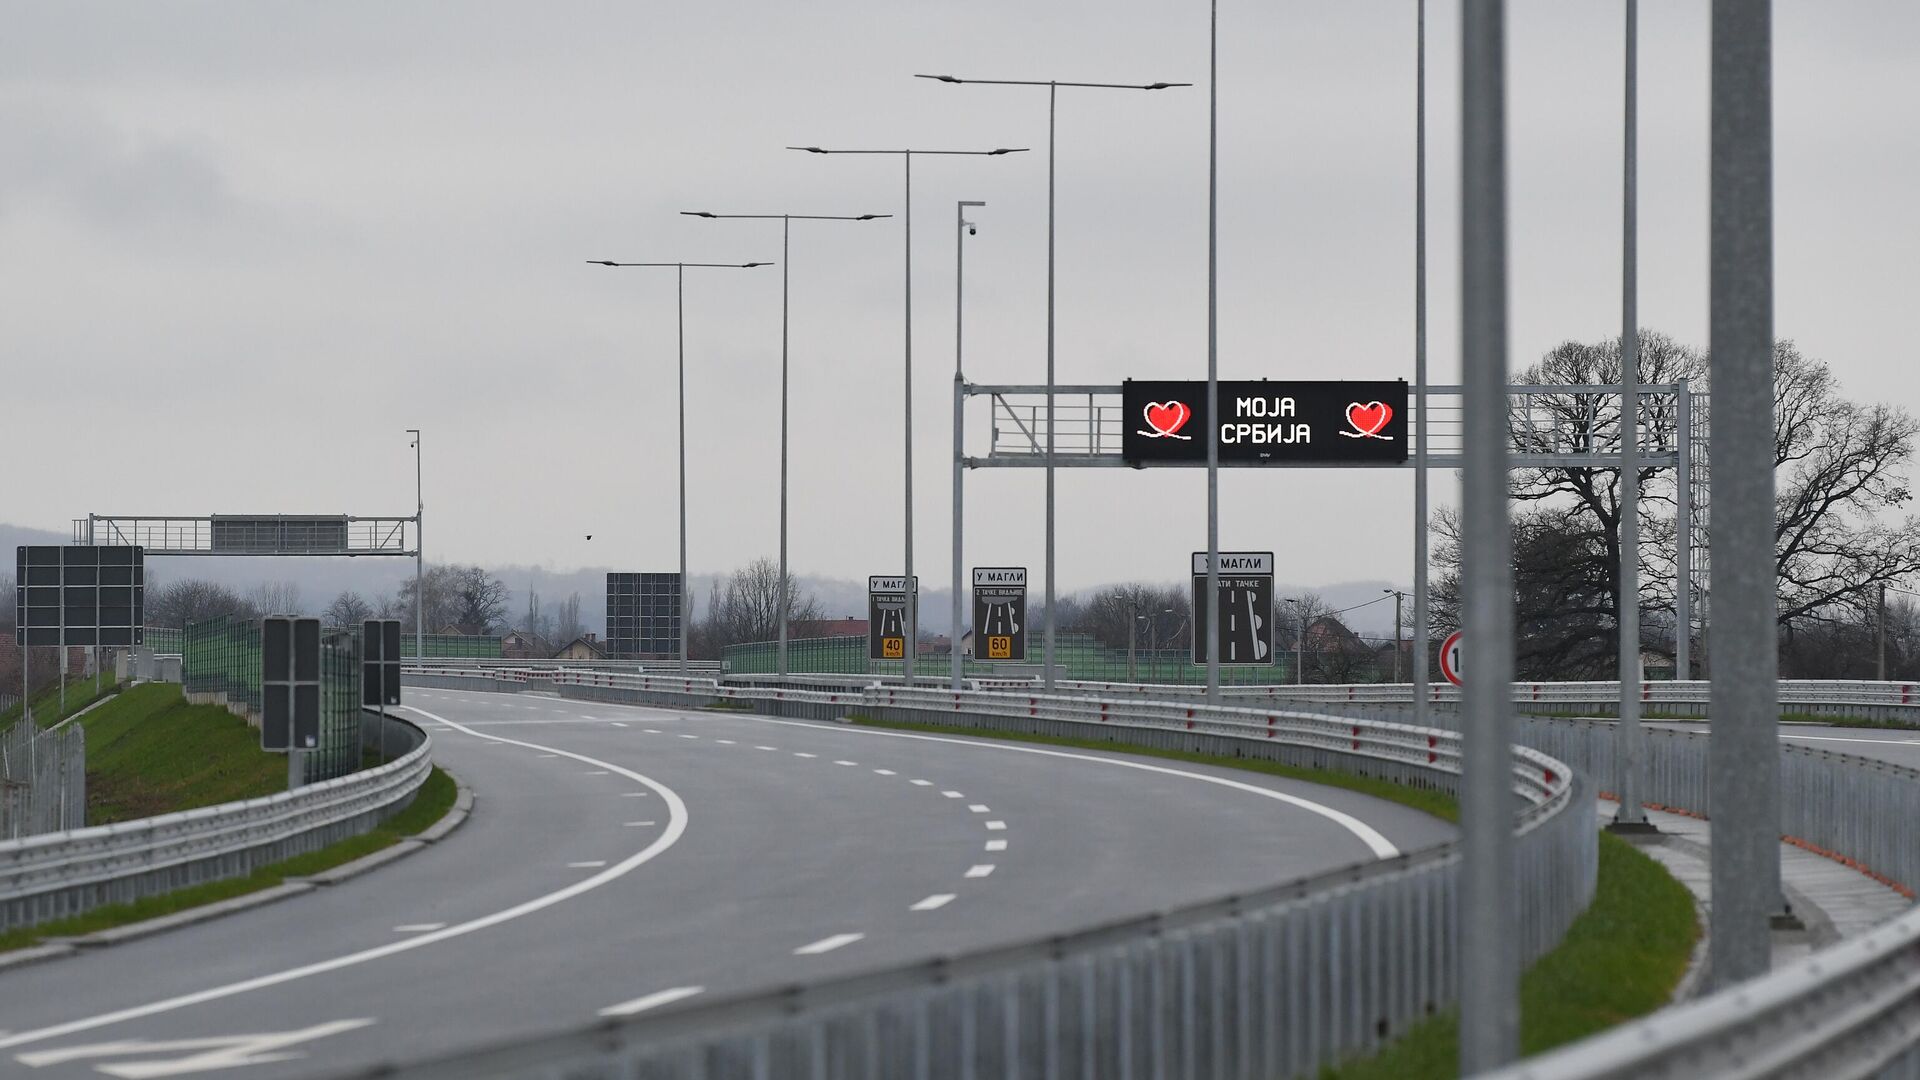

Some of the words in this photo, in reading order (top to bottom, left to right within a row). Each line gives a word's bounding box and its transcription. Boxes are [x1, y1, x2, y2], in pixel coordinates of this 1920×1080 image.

[1236, 397, 1295, 417] МОЈА
[1221, 424, 1311, 444] СРБИЈА
[1220, 558, 1262, 569] МАГЛИ
[977, 572, 983, 581] У
[987, 572, 1023, 581] МАГЛИ
[872, 580, 879, 589] У
[882, 580, 914, 589] МАГЛ
[1217, 580, 1231, 588] АТИ
[1235, 580, 1260, 588] ТАЧКЕ
[886, 639, 900, 651] 40
[992, 638, 1008, 650] 60
